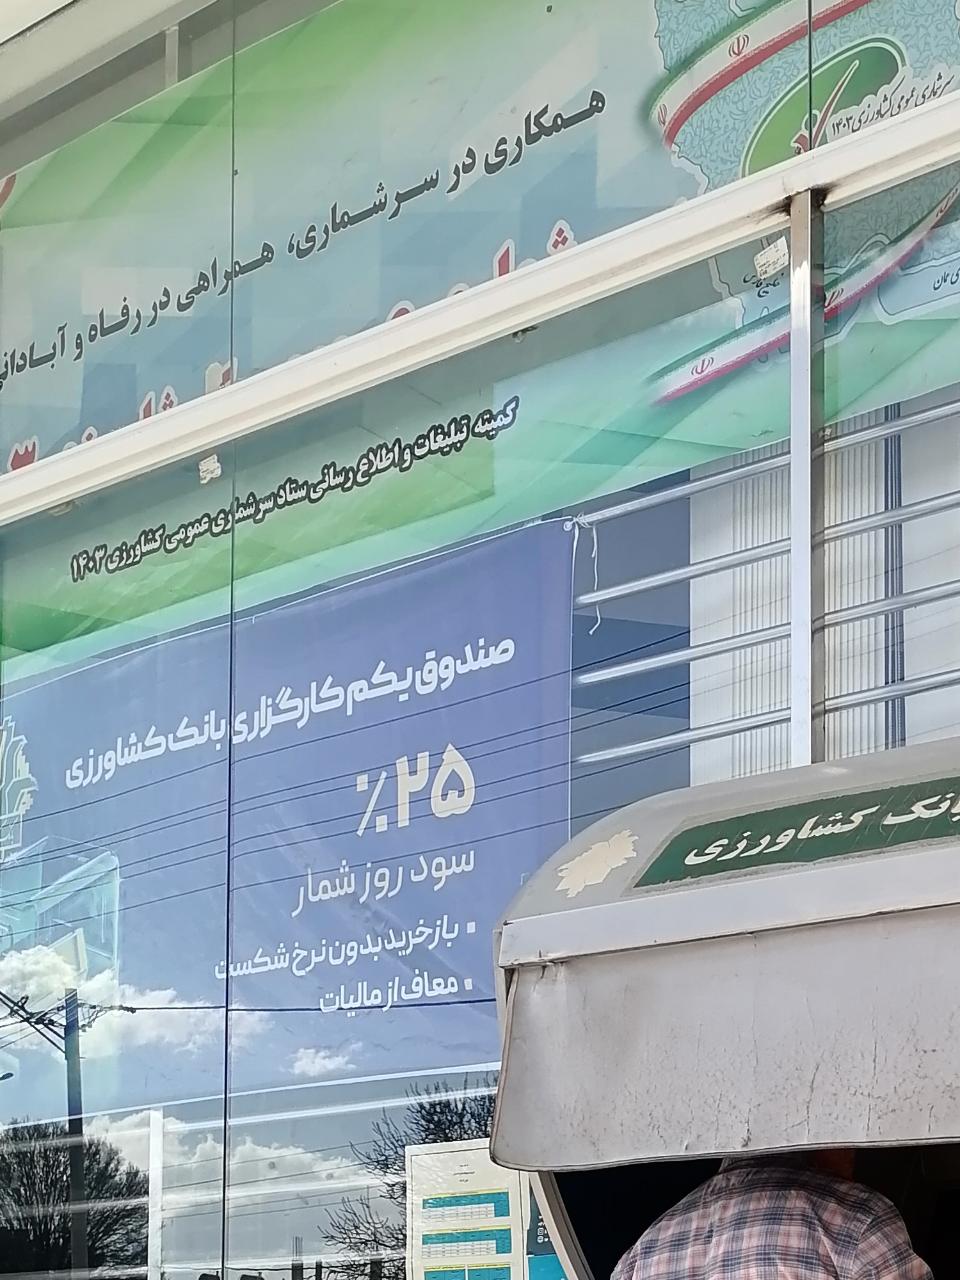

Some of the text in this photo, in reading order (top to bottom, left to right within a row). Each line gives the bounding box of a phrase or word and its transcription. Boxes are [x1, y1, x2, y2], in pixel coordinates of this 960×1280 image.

[852, 75, 905, 133] کشاورزی
[890, 86, 916, 117] عمومی
[484, 90, 606, 175] همکاری
[446, 147, 477, 194] در
[176, 241, 275, 312] همراهی
[88, 296, 142, 342] رفاه
[147, 286, 171, 327] در
[0, 323, 68, 390] آبادان
[73, 332, 84, 361] و
[72, 400, 518, 580] کمیته تبلیغات و اطلاع رسانی ستاد سرشماری عمومی کشاورزی ۱۴۰۳
[65, 637, 515, 789] صندوق یکم کارگزاری بانک کشاورزی
[684, 805, 879, 865] کشاورزی
[291, 850, 475, 918] سود روز شمار
[214, 942, 289, 980] شکست
[291, 939, 326, 977] نرخ
[328, 933, 383, 966] بدون
[319, 968, 459, 1017] معاف از مالیات
